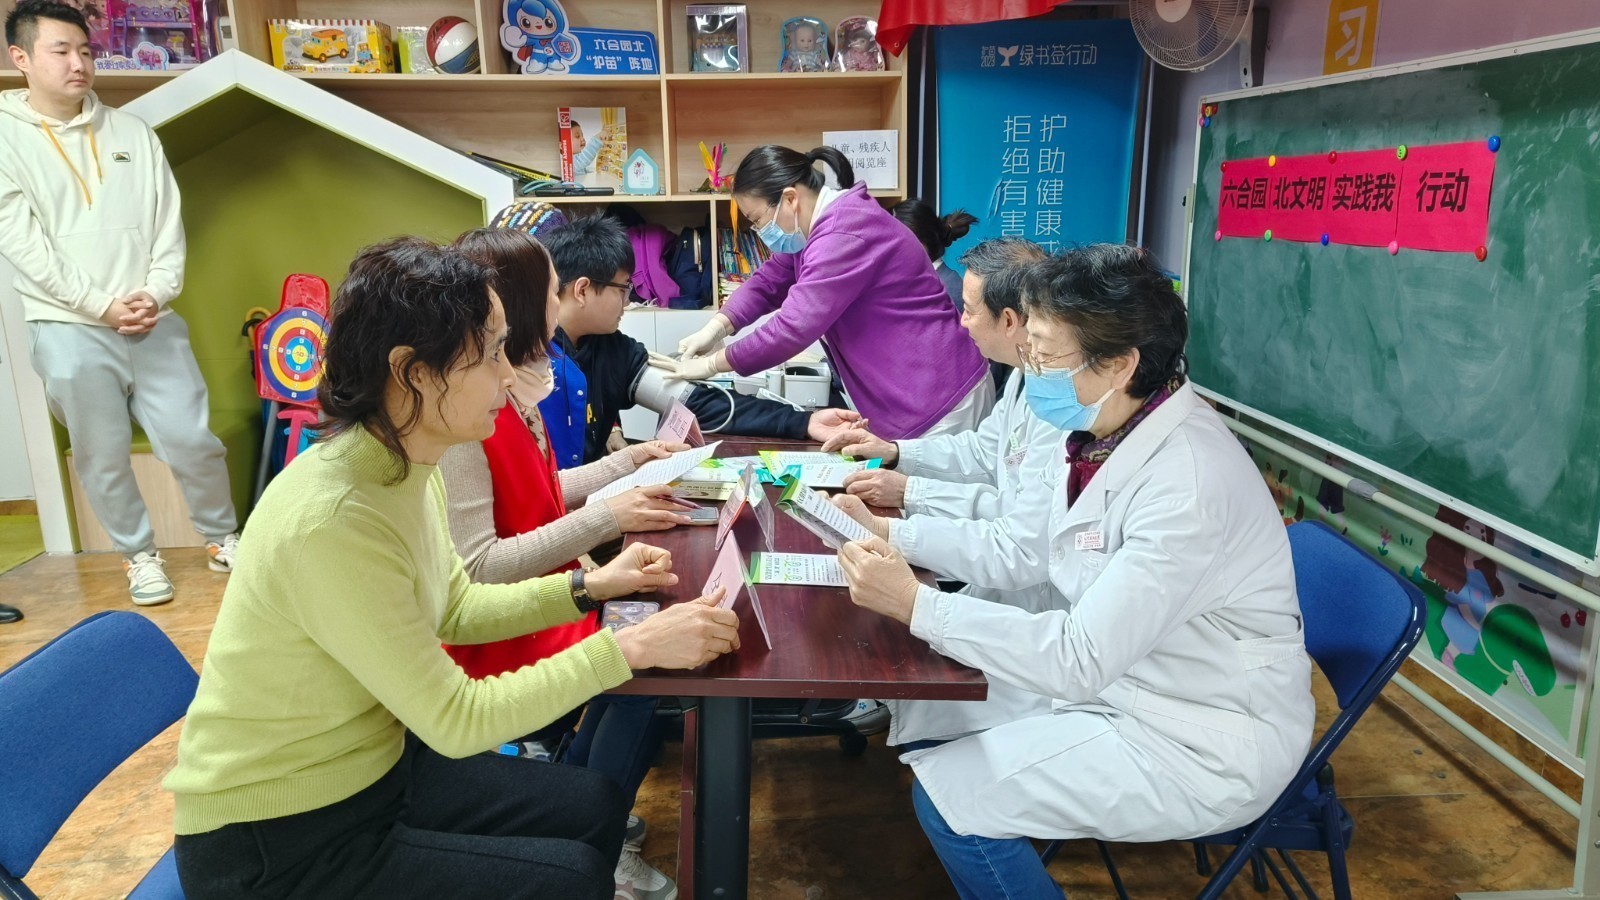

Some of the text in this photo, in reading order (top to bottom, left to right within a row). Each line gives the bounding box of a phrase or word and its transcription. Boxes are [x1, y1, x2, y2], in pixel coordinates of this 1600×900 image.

[594, 38, 646, 52] 六合园北
[1019, 44, 1098, 66] 绿书签行动
[1334, 6, 1368, 66] 习
[1000, 115, 1031, 237] 拒绝有害
